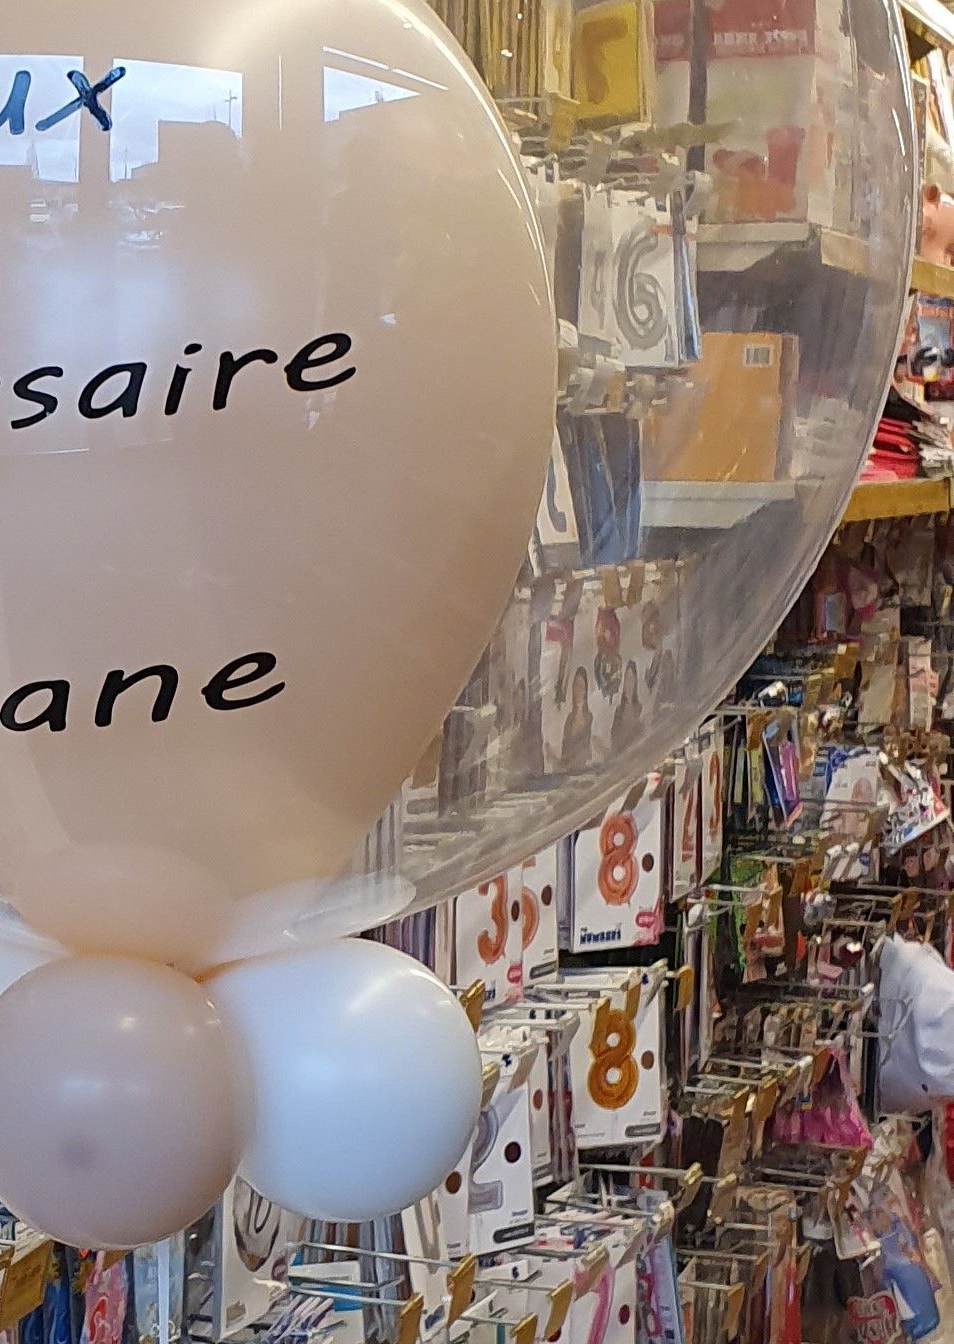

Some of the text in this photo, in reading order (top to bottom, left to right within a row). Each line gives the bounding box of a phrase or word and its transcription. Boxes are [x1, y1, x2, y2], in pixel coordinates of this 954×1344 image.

[598, 811, 639, 906] 8
[477, 871, 508, 966] 3
[587, 1009, 640, 1111] 8
